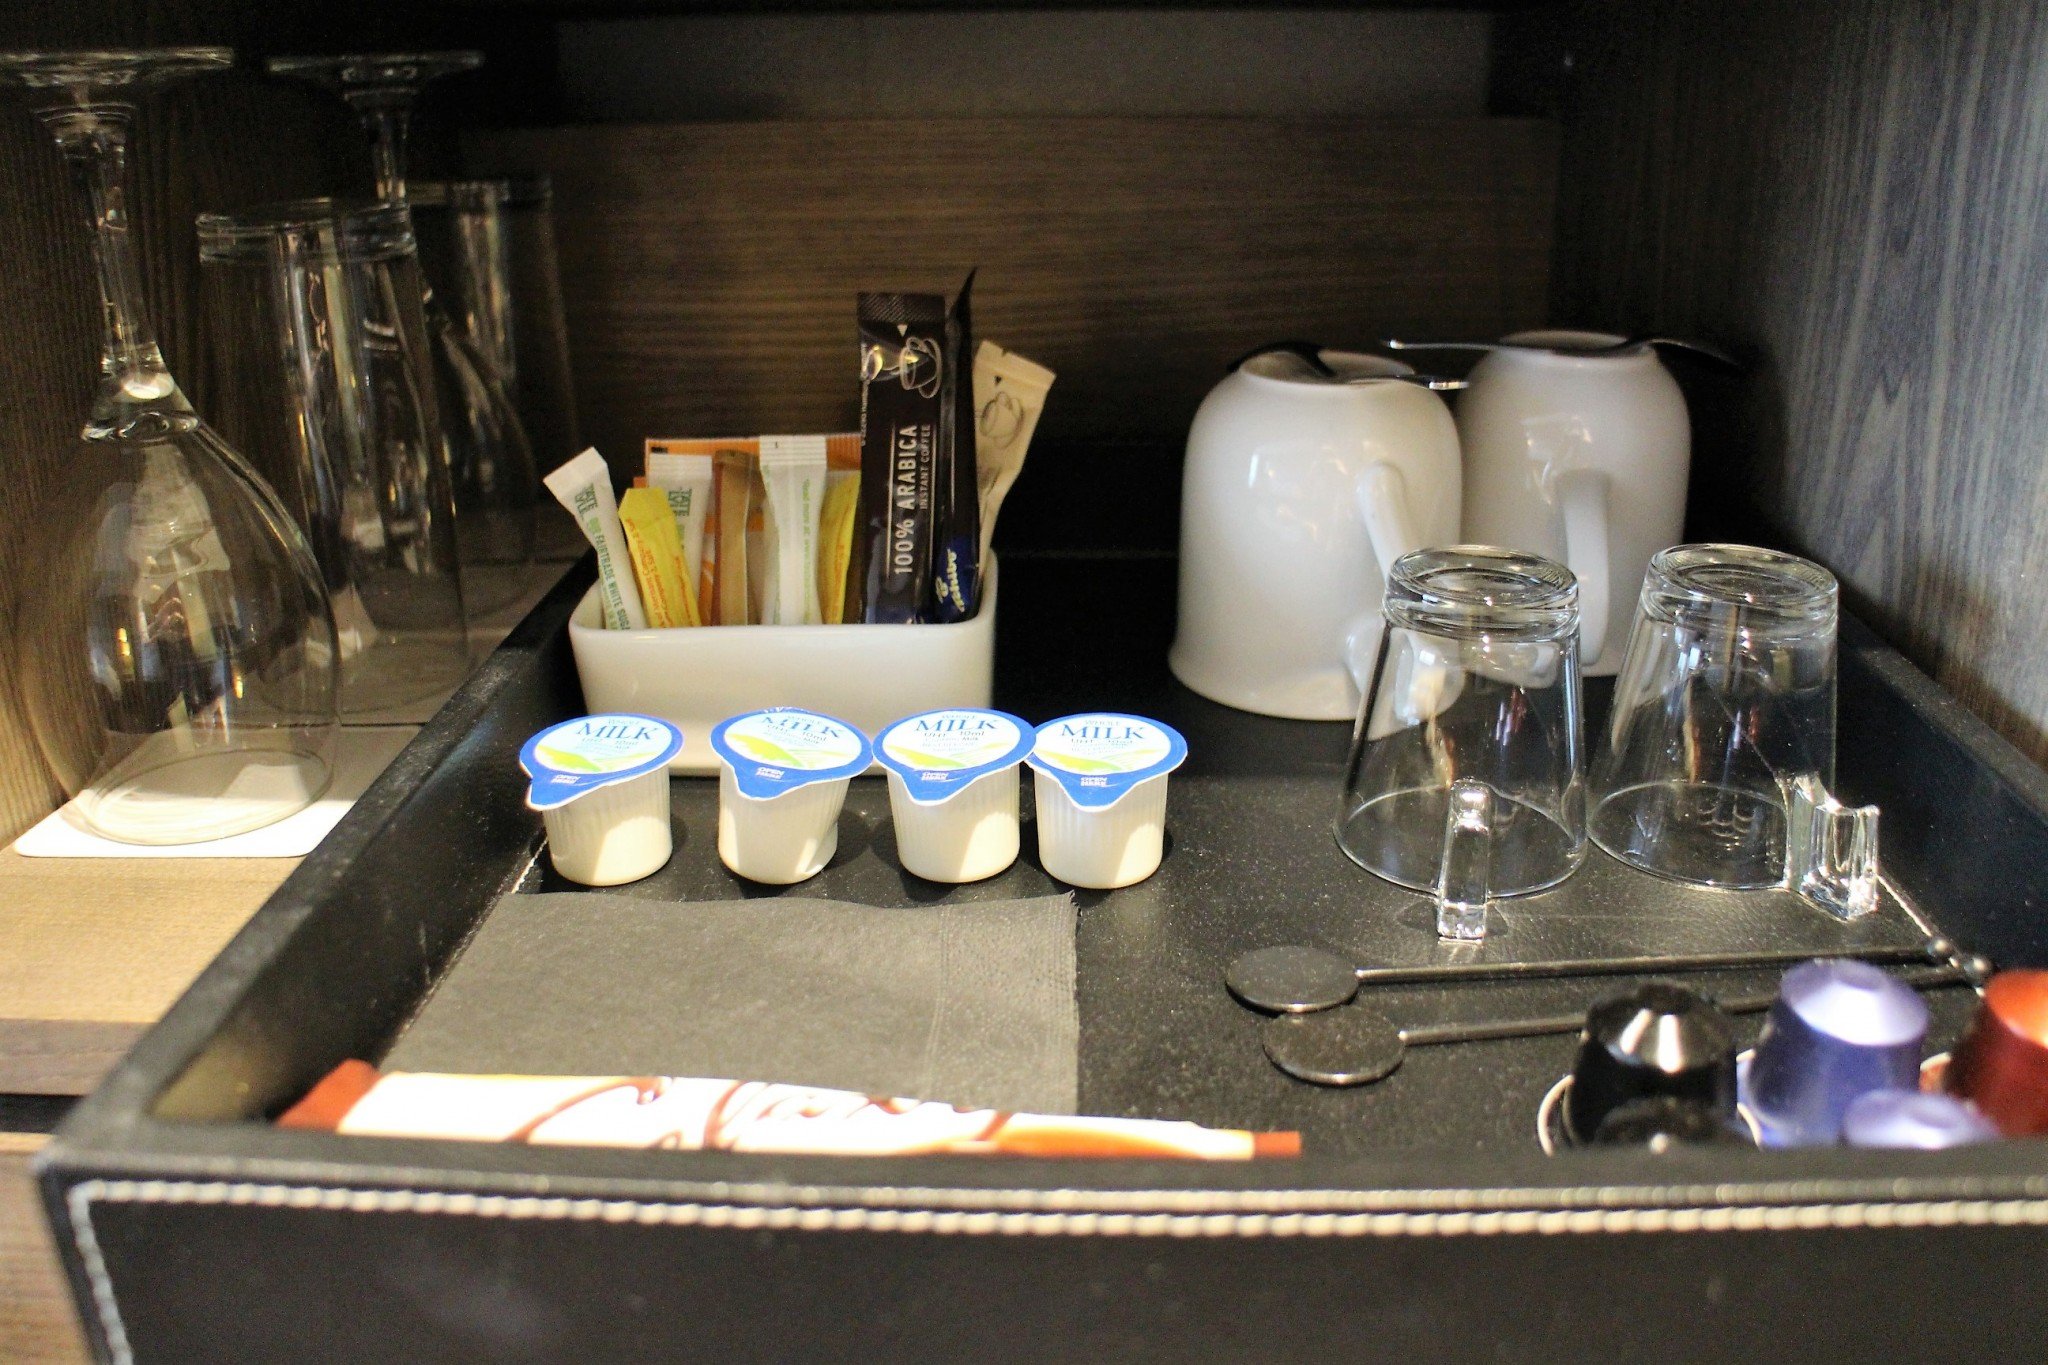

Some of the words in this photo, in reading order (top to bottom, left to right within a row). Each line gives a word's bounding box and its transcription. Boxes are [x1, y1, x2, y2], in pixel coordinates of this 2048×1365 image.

[920, 424, 931, 463] COFFEE
[896, 425, 917, 510] ARABICA
[919, 466, 930, 510] INSTANT
[893, 518, 914, 574] 100%
[595, 535, 615, 580] FAIRTRADE
[608, 581, 623, 608] WHITE
[946, 548, 965, 612] Tchibo
[576, 722, 659, 740] MILK
[763, 716, 846, 738] MILK
[914, 719, 1000, 732] MILK
[1061, 723, 1147, 739] MILK
